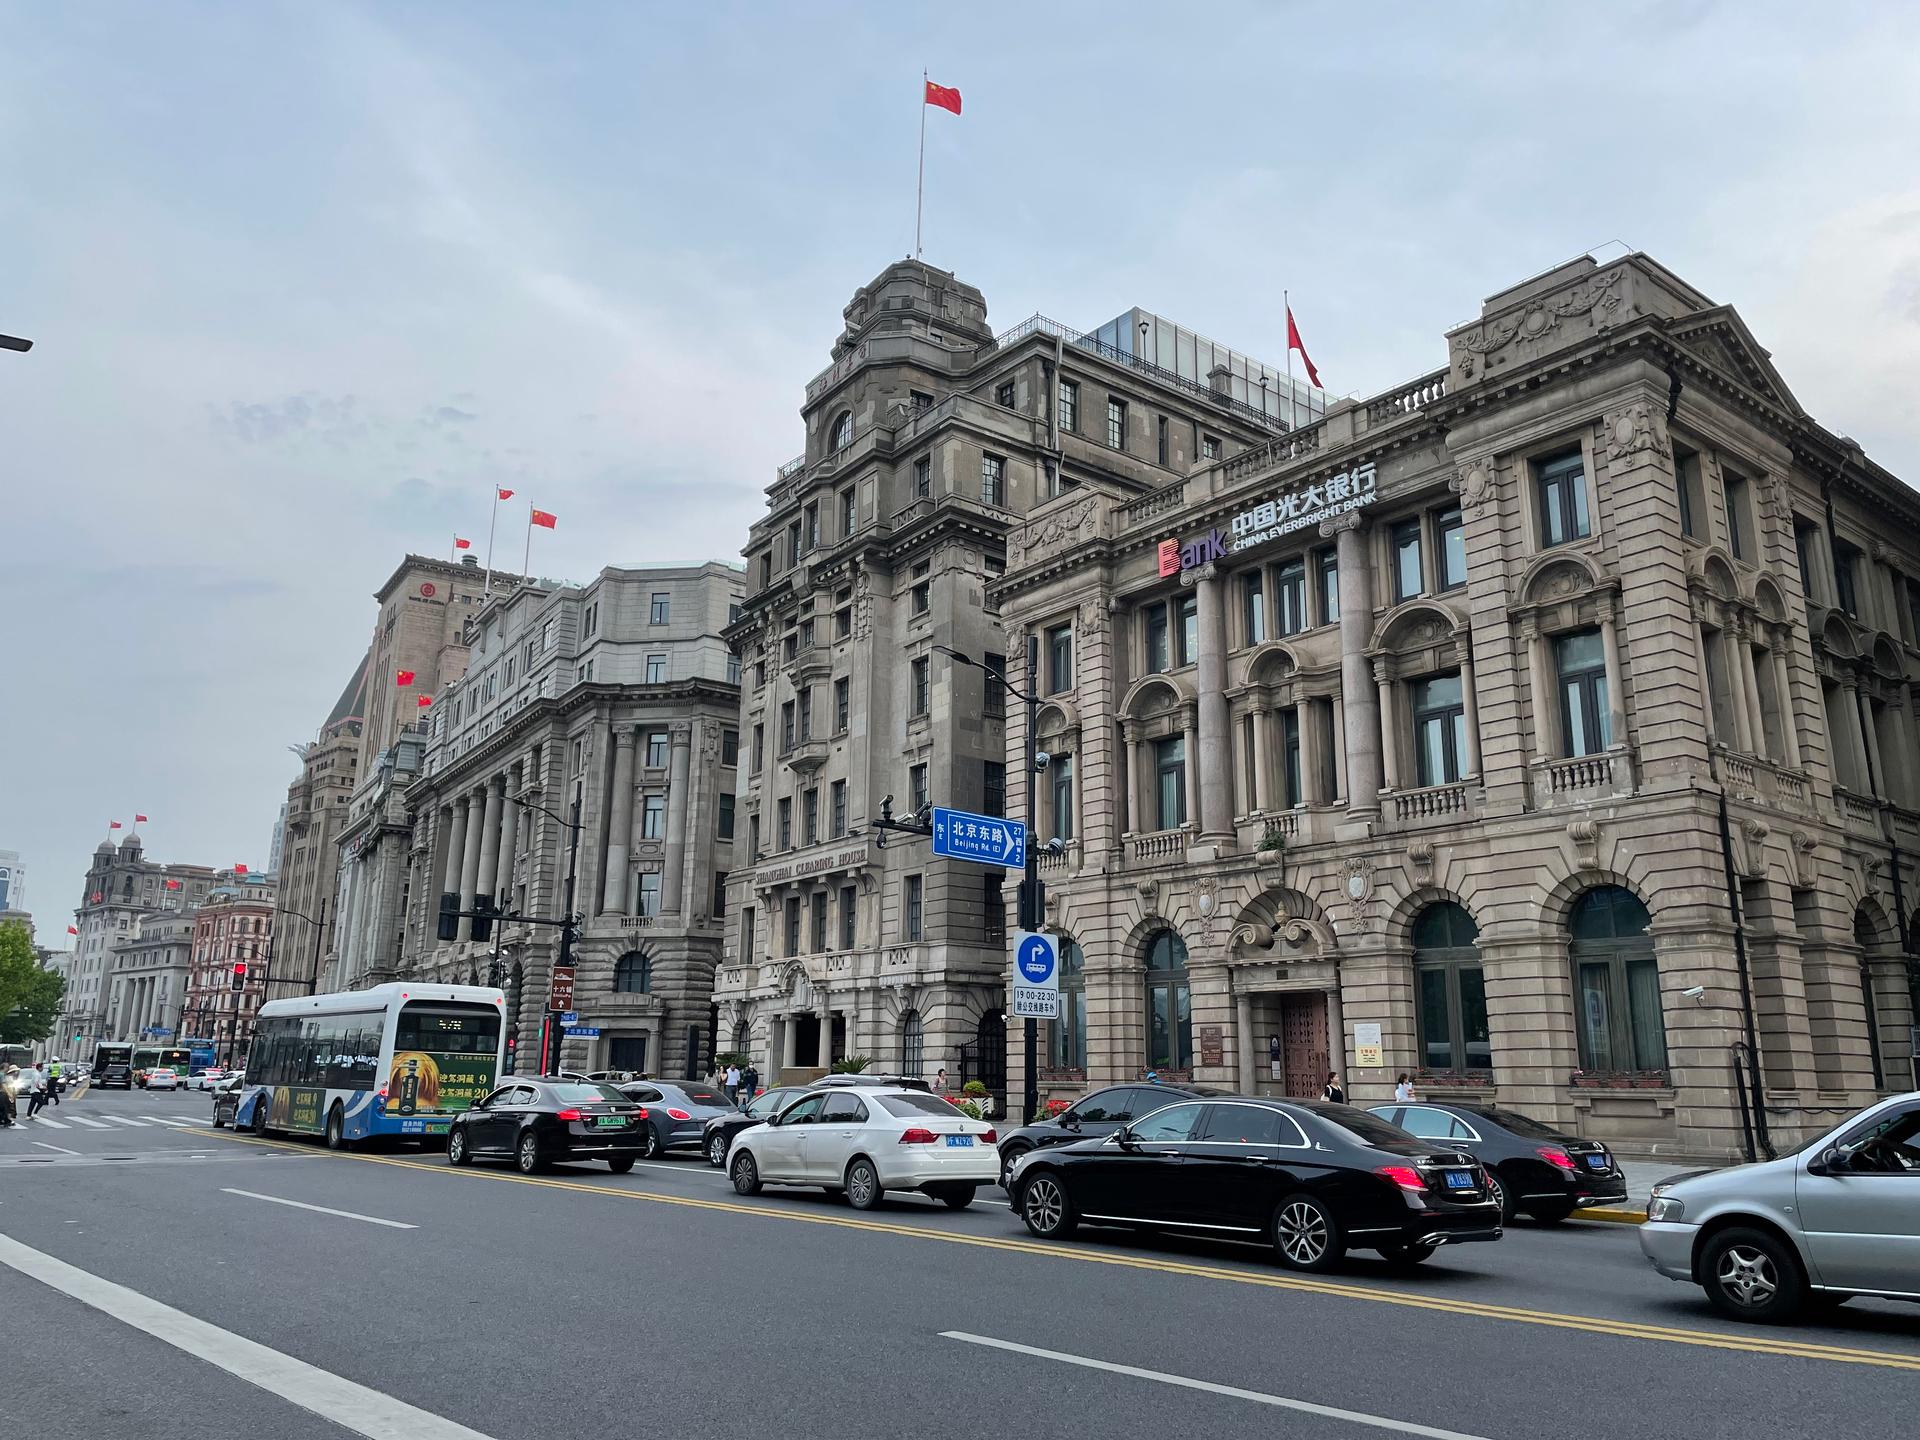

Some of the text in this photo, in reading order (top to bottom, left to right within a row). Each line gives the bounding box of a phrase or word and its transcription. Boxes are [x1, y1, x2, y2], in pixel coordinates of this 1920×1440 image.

[1231, 462, 1377, 536] 中国光大银行
[1233, 490, 1378, 551] CHINA EVERBRIGHT BANK
[1158, 528, 1228, 578] Bank
[953, 821, 1003, 843] 北京东路
[1013, 827, 1022, 836] 27
[954, 838, 979, 851] Beijing
[756, 849, 866, 884] SHANGHAI CLEARING HOUSE
[1015, 854, 1021, 863] 2
[1016, 990, 1055, 1001] 1900-2230
